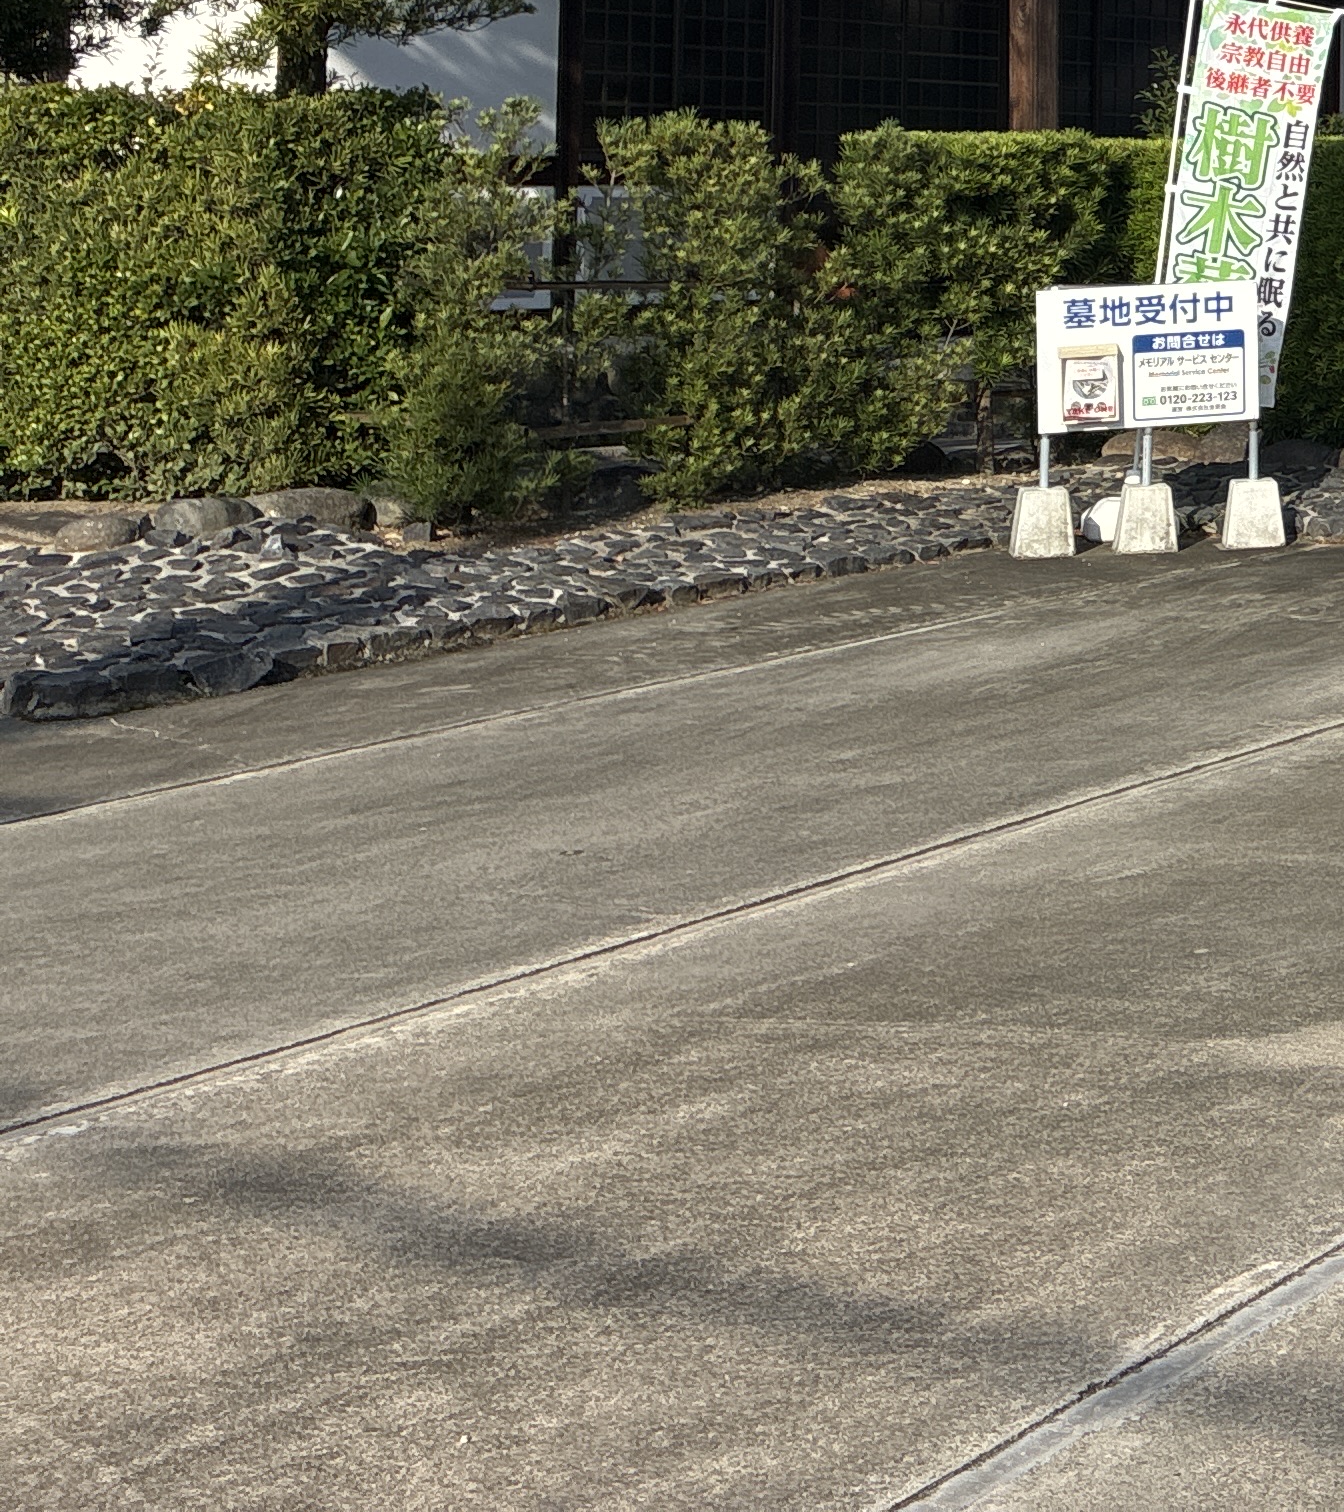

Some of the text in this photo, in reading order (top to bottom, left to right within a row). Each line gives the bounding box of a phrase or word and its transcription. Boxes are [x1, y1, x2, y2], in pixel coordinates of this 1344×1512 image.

[1225, 13, 1315, 48] 永代供養
[1220, 42, 1311, 76] 宗教自由
[1206, 67, 1316, 106] 後継者不要
[1257, 119, 1310, 337] 自然と共に眠る
[1063, 291, 1233, 329] 墓地受付中
[1152, 333, 1225, 349] お問合せは
[1160, 391, 1238, 405] 0120-223-123
